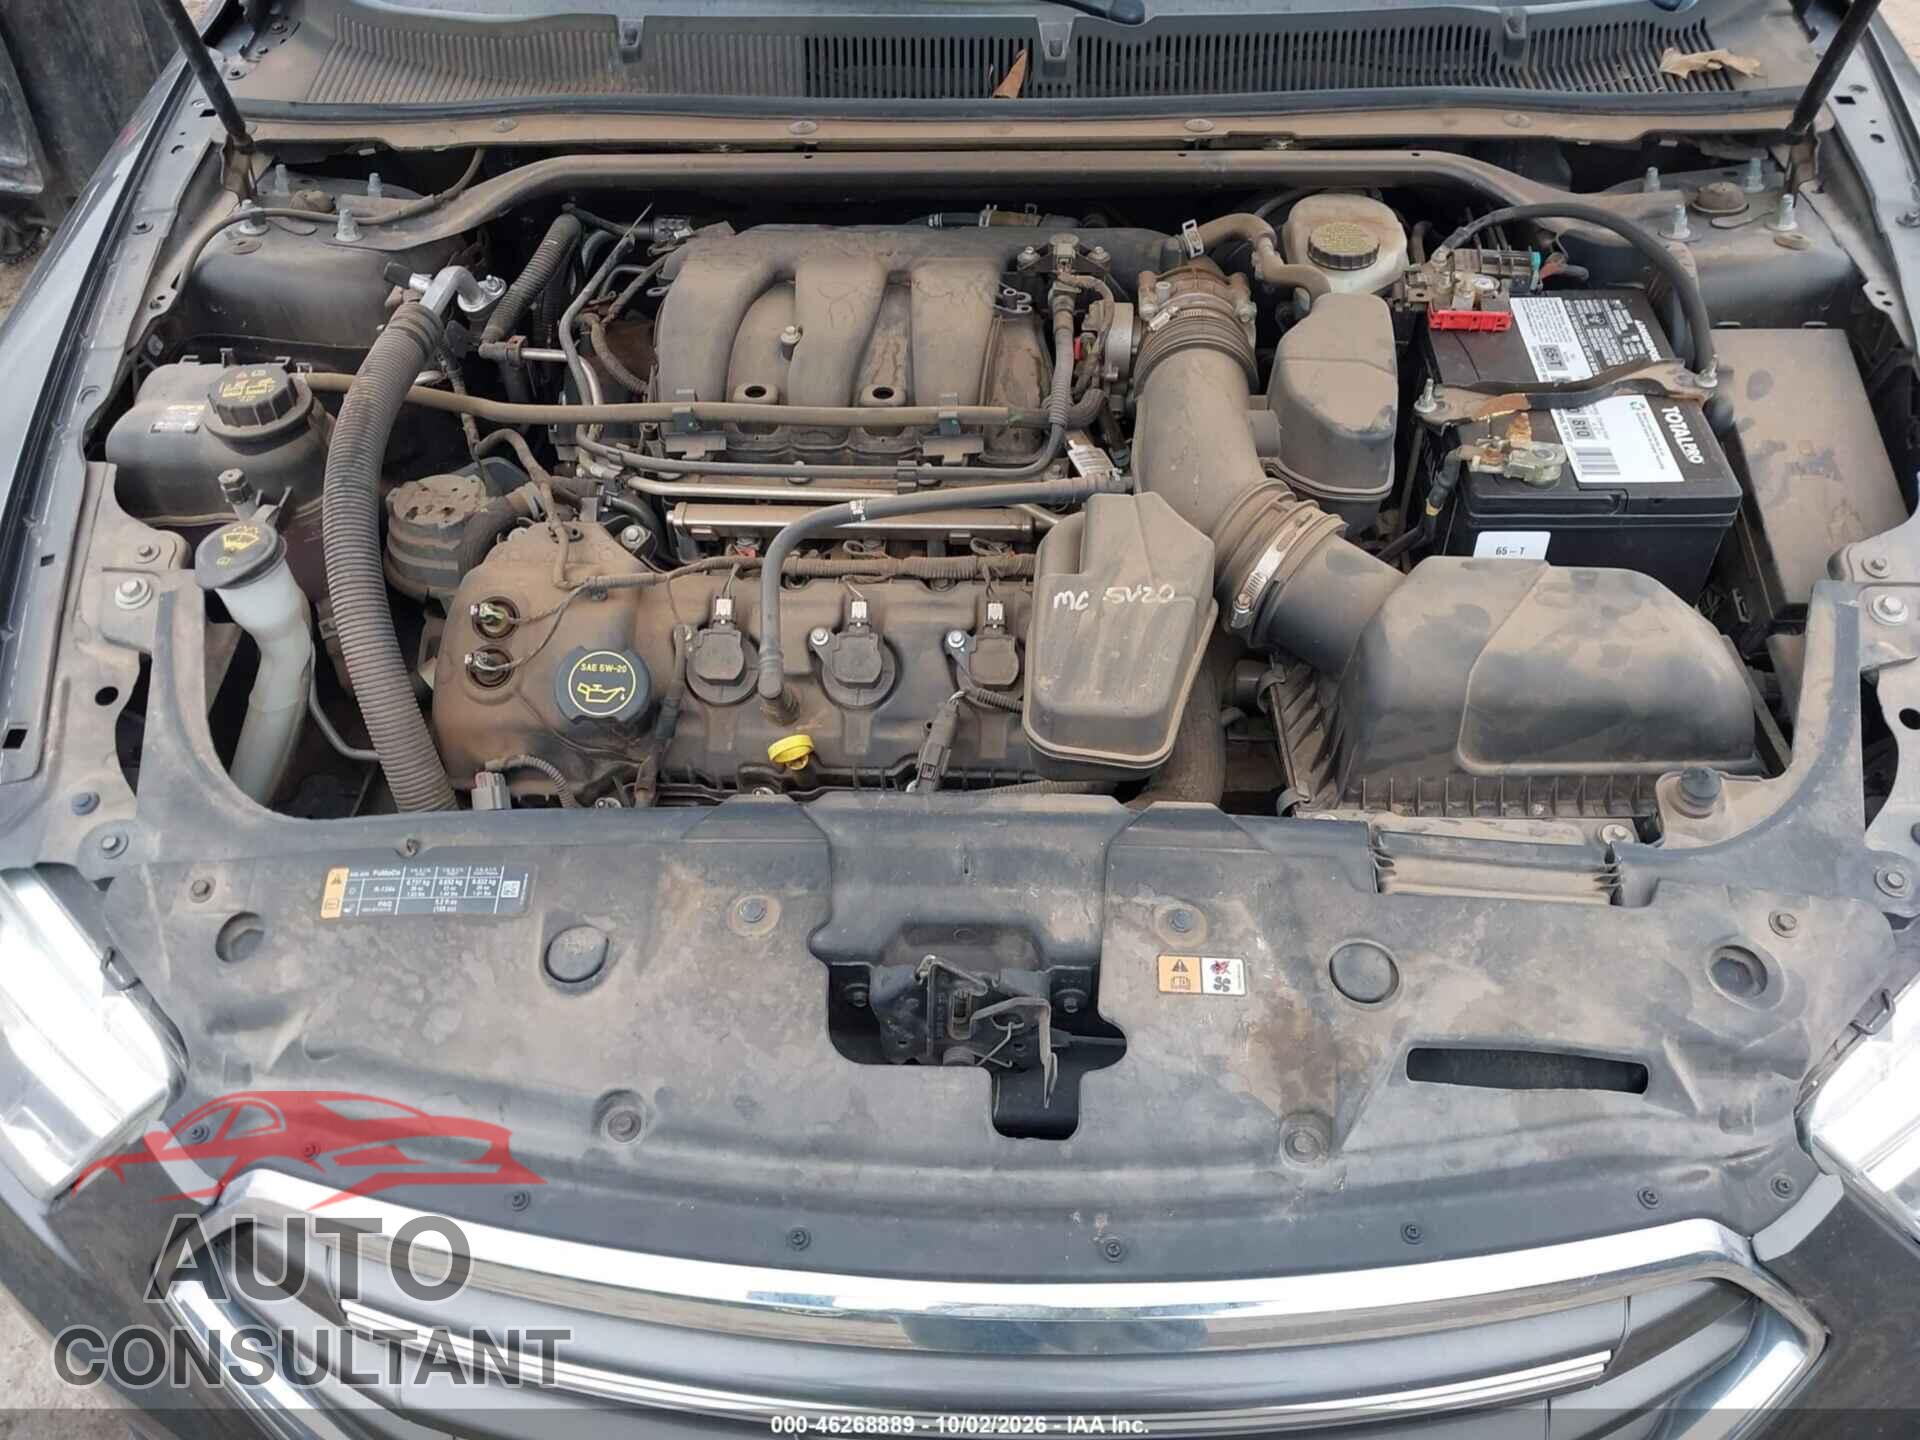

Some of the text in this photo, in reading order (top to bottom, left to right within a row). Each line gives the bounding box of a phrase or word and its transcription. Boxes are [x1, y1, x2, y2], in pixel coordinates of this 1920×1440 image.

[1661, 405, 1705, 464] TOTALPRO
[580, 663, 628, 673] SAE 5W-20
